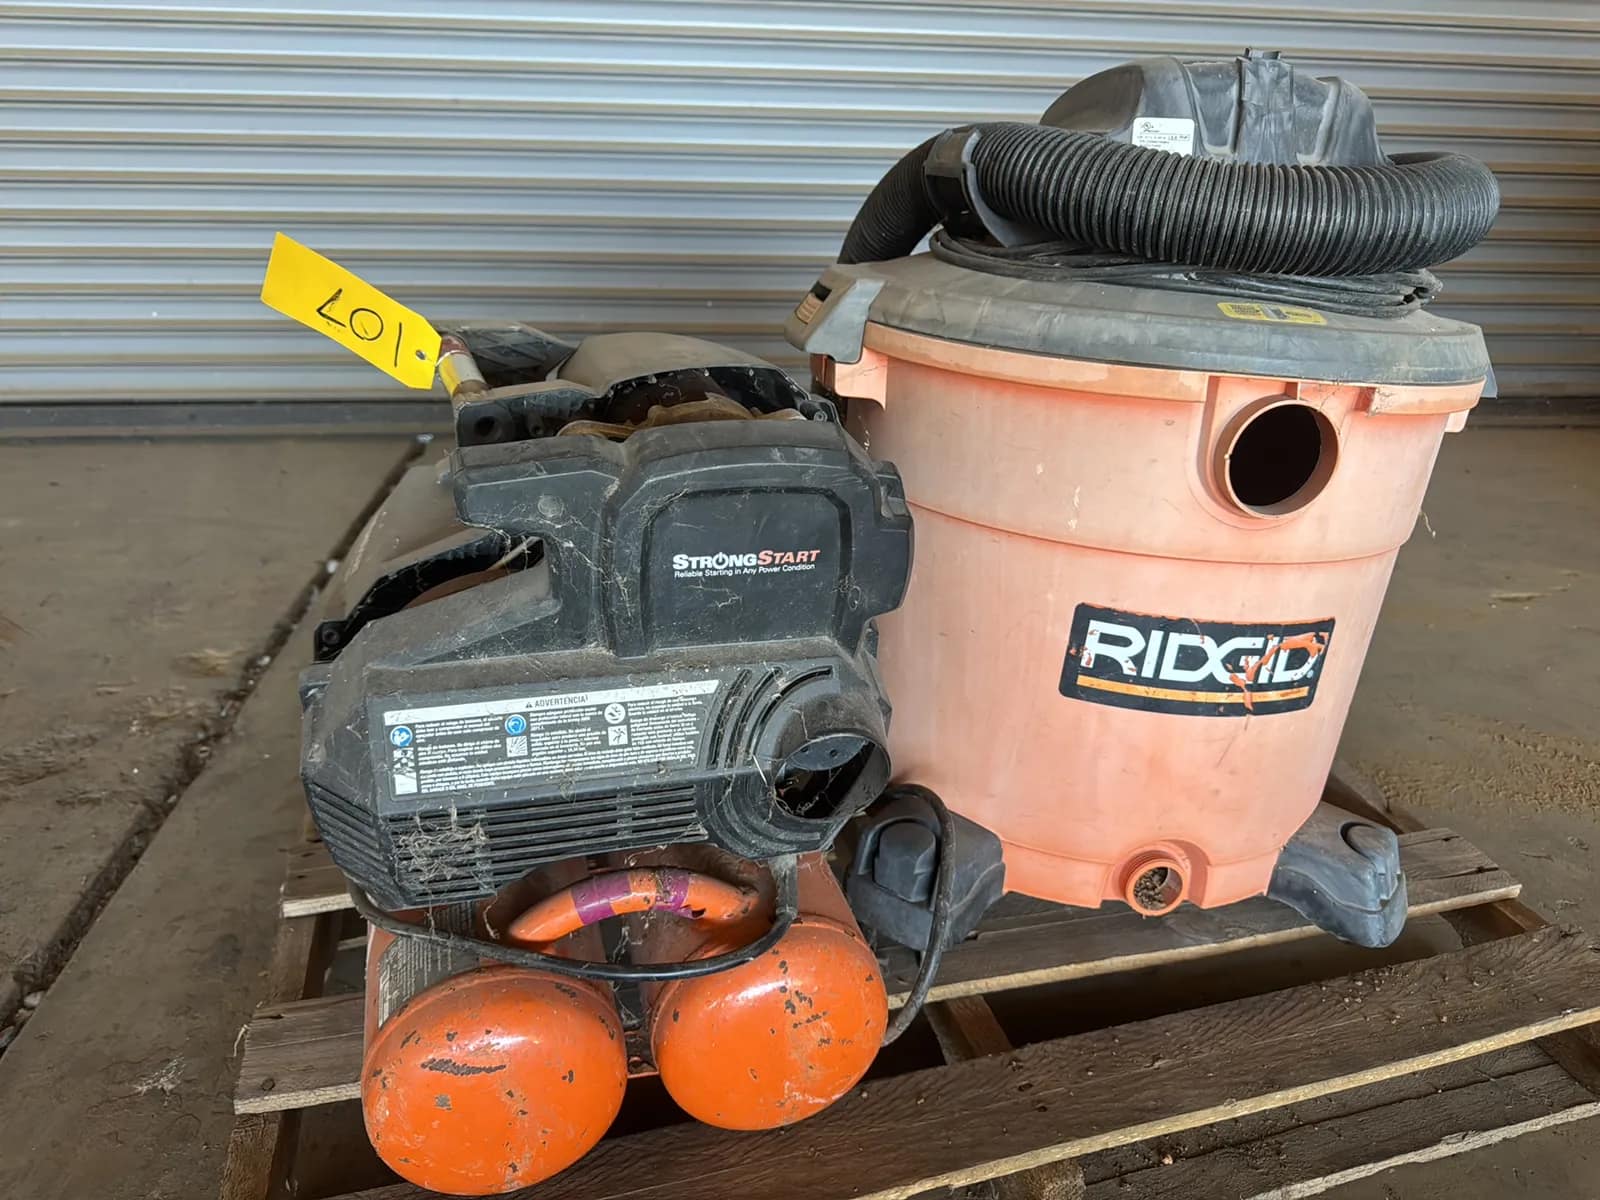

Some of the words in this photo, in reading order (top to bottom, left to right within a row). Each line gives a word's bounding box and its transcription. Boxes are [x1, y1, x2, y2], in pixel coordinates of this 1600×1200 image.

[674, 570, 703, 578] Reliable
[704, 568, 733, 577] Starting
[743, 566, 757, 575] Any
[758, 565, 781, 574] Power
[782, 563, 816, 572] Condition
[1080, 619, 1330, 685] RIDGID
